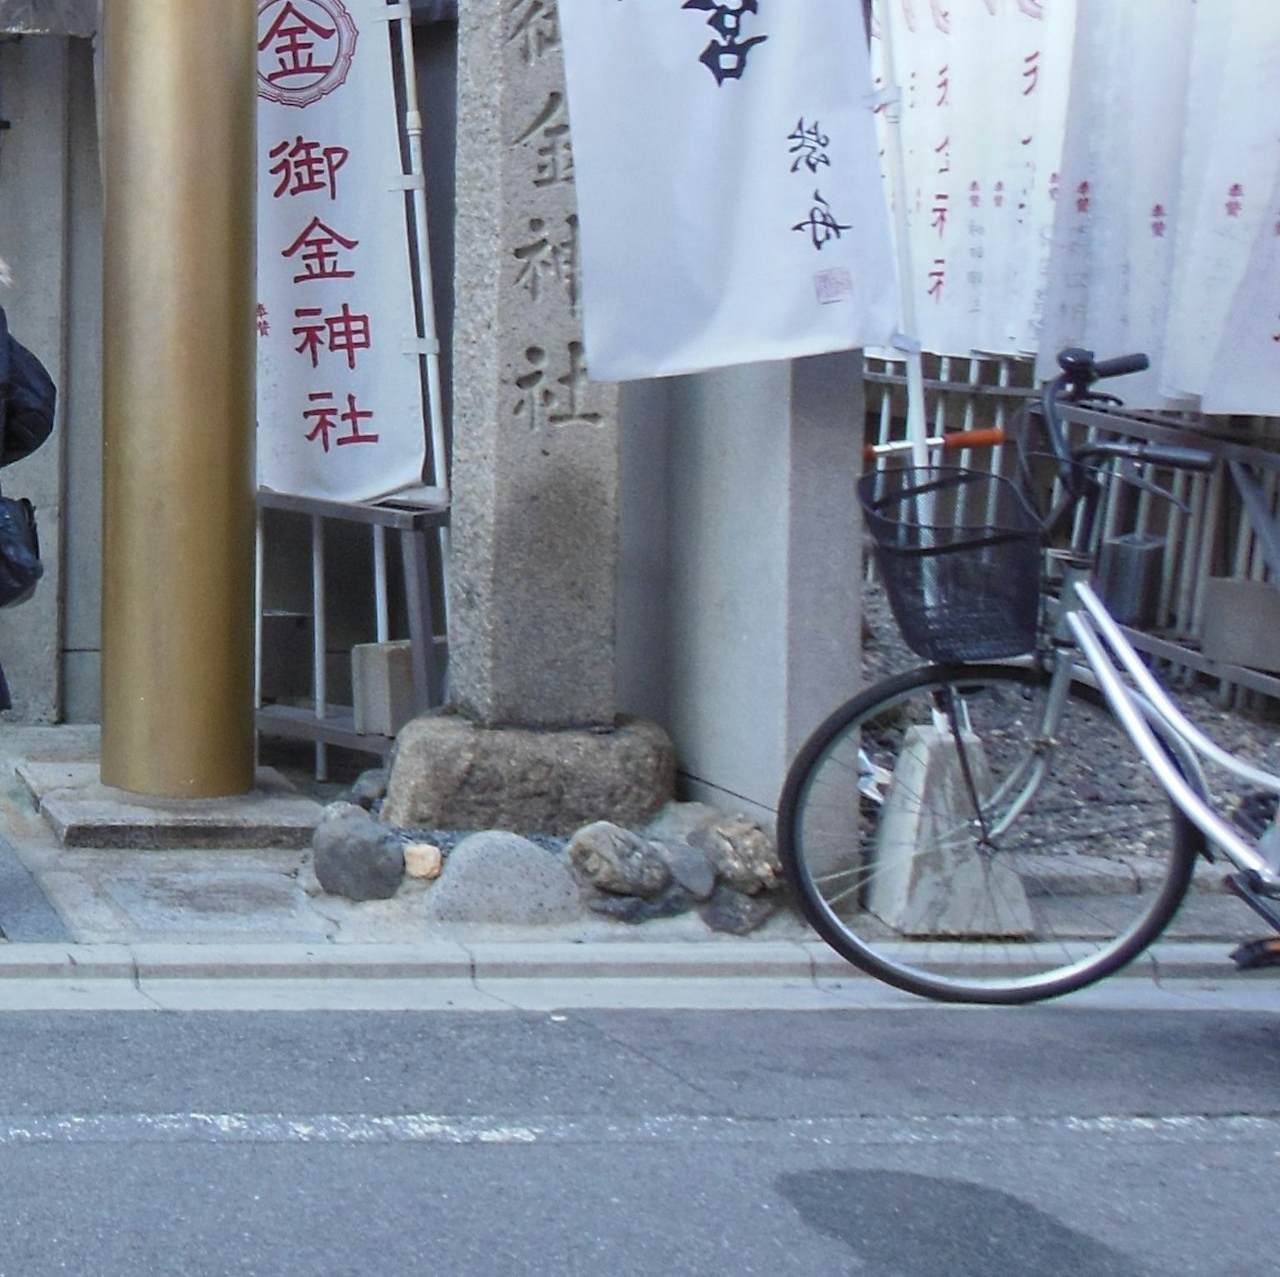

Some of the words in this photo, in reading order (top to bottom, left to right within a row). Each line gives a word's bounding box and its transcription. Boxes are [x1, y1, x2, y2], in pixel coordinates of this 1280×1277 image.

[259, 0, 337, 83] 金
[268, 137, 379, 454] 御金神社
